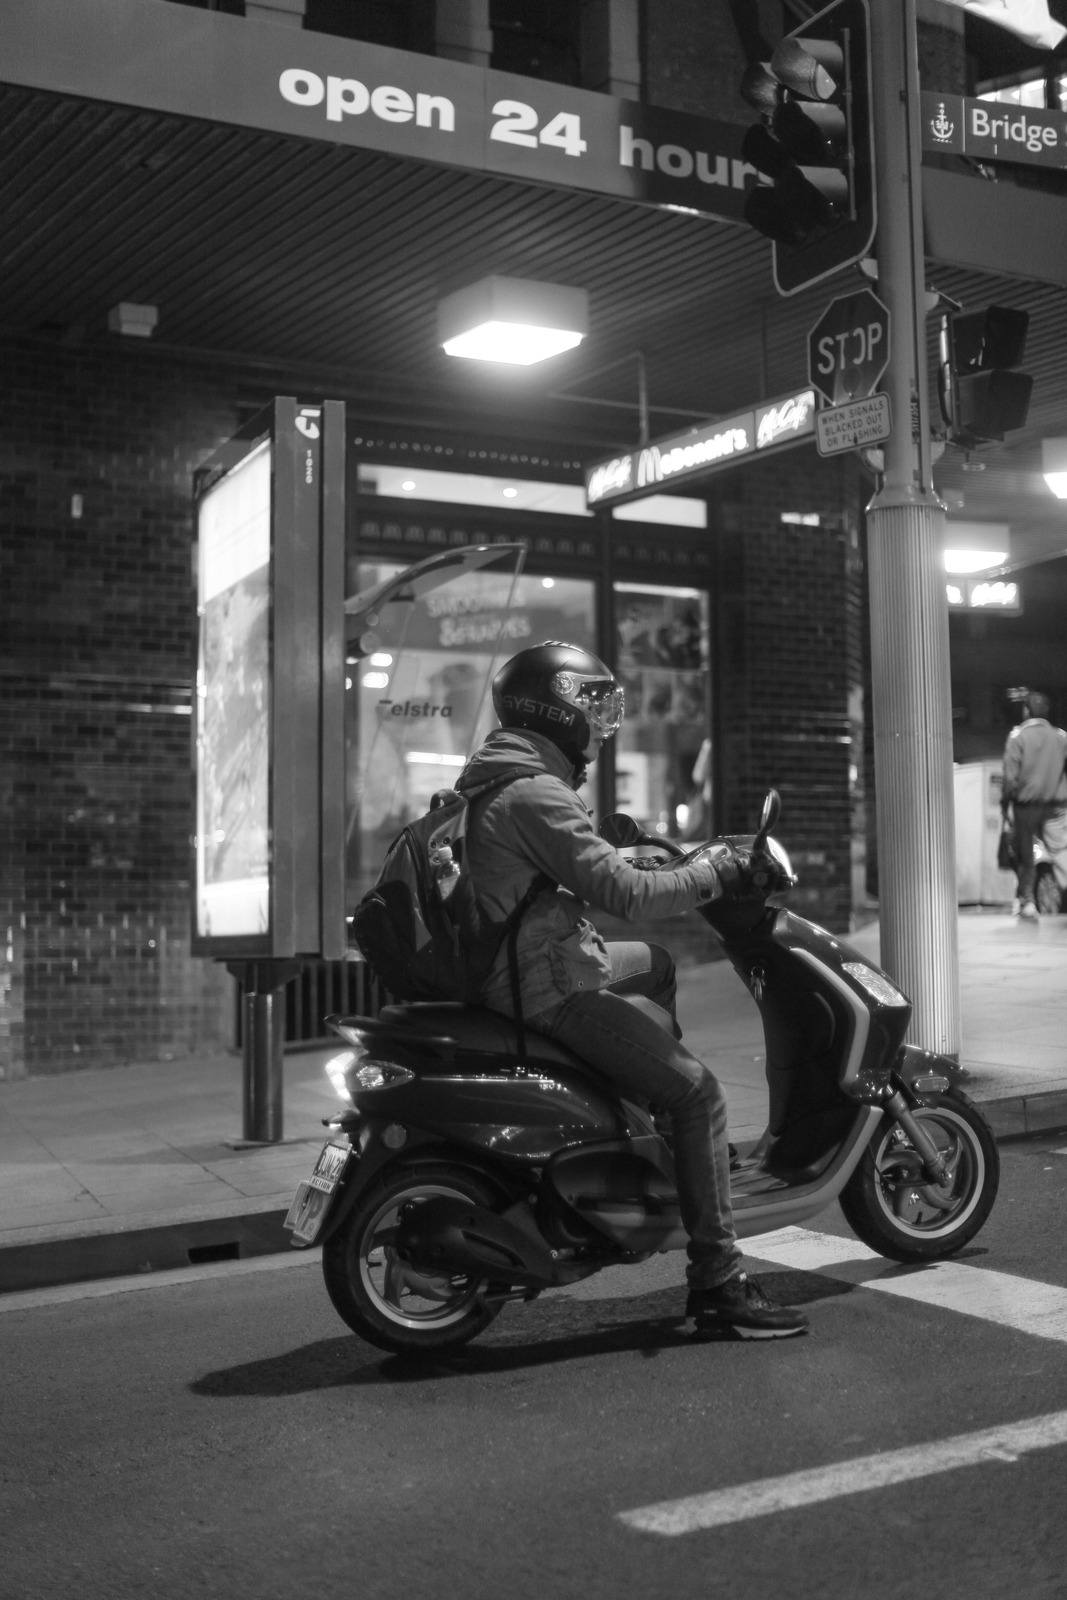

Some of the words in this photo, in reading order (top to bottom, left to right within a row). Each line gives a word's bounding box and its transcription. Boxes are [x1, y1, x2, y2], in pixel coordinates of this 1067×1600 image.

[278, 68, 455, 132] open
[490, 99, 587, 157] 24
[972, 108, 1058, 152] Bridge
[822, 411, 846, 426] WHEN
[849, 401, 884, 418] SIGNALS
[824, 418, 863, 437] BLACKED
[866, 413, 882, 425] OUT
[827, 437, 839, 448] OR
[842, 425, 884, 444] FLASHING
[502, 695, 576, 727] SYSTEM
[311, 1178, 332, 1191] ACTION
